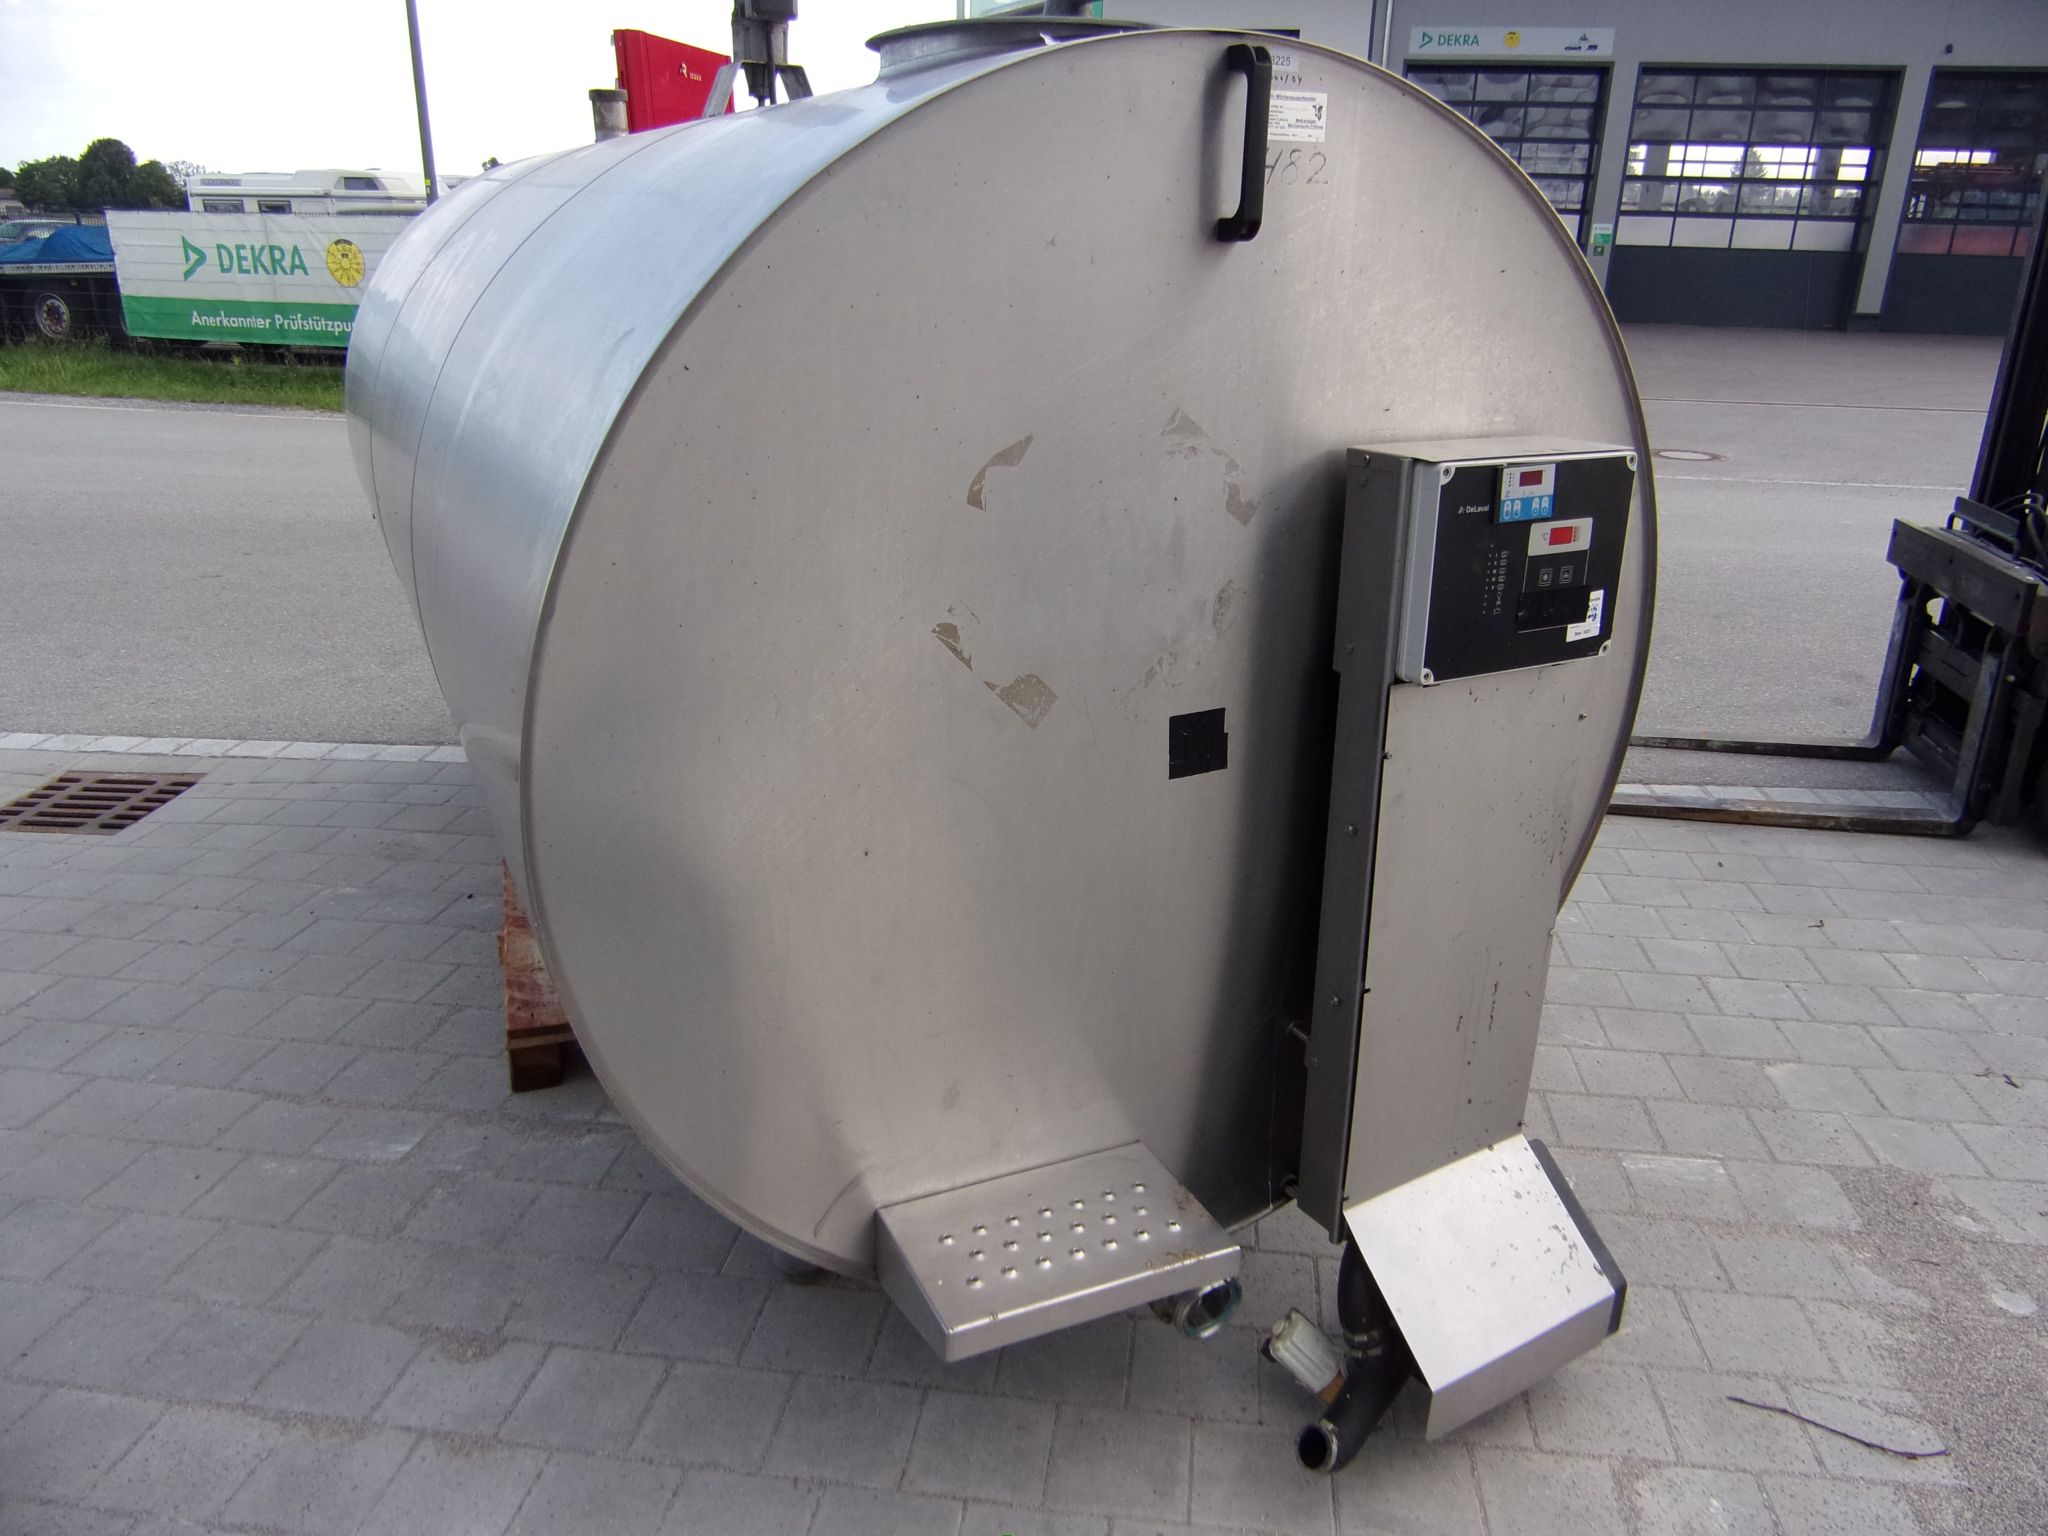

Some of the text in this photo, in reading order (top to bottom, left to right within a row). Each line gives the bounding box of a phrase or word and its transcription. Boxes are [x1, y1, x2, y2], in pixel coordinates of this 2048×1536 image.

[1437, 34, 1480, 47] DEKRA
[215, 243, 310, 277] DEKRA
[191, 310, 272, 329] Anerkannter
[1465, 505, 1490, 514] DeLaval
